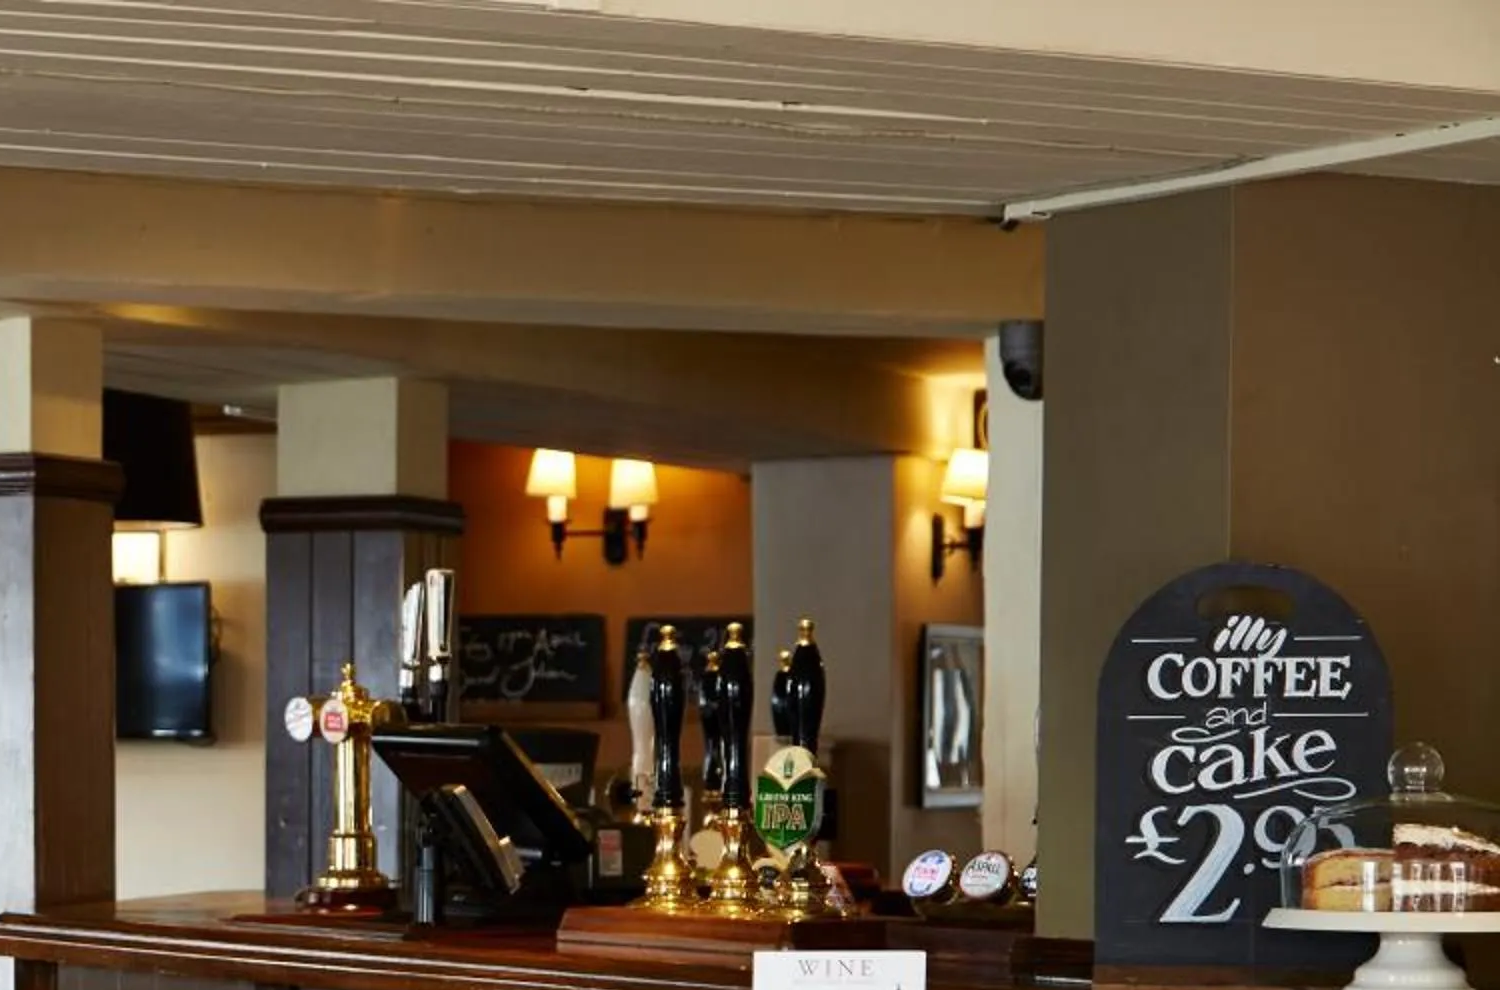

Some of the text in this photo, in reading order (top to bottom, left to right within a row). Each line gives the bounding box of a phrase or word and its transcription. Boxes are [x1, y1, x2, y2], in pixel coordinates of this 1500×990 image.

[1213, 615, 1288, 656] illy
[1147, 653, 1353, 701] COFFEE
[1205, 702, 1268, 729] and
[761, 803, 808, 830] IPA
[798, 958, 876, 977] WINE
